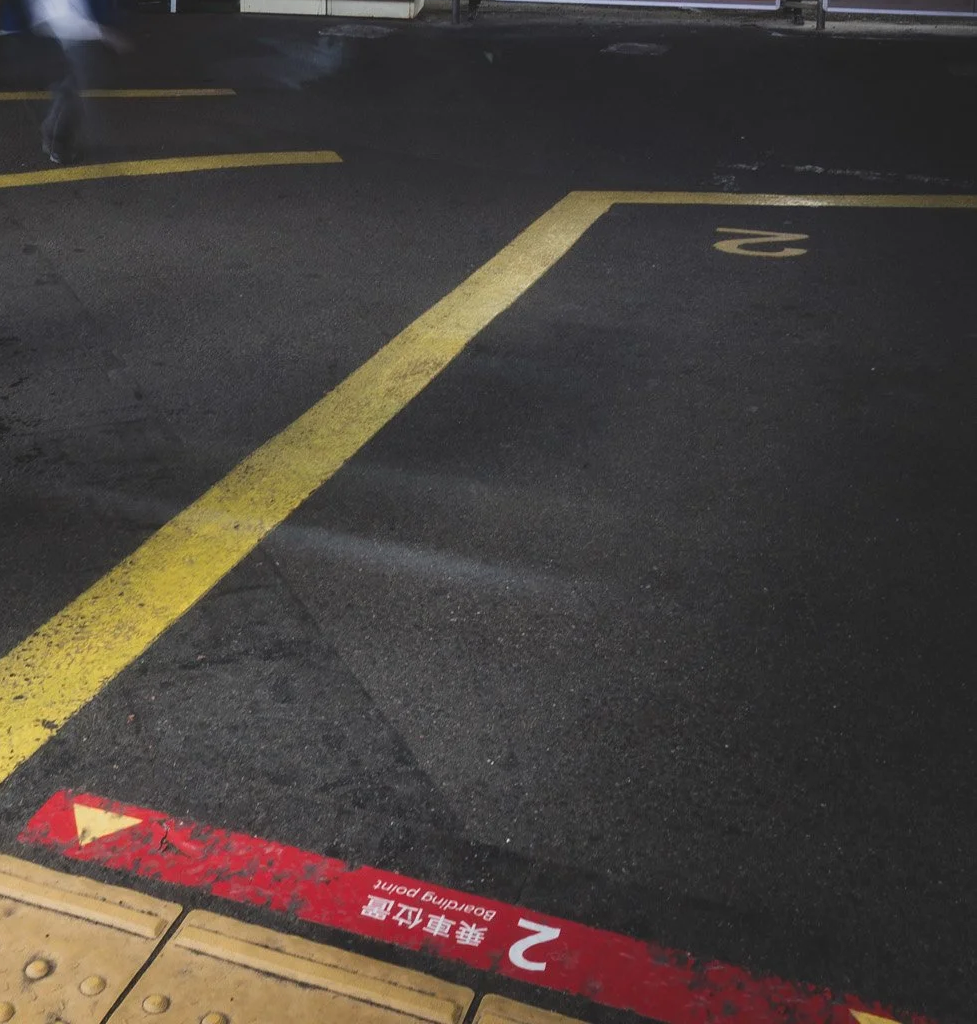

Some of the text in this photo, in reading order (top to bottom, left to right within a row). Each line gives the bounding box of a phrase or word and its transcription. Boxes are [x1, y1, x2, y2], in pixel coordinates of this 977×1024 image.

[361, 894, 489, 947] 乗車位置
[373, 879, 497, 922] Boarding point
[508, 917, 561, 972] 2
